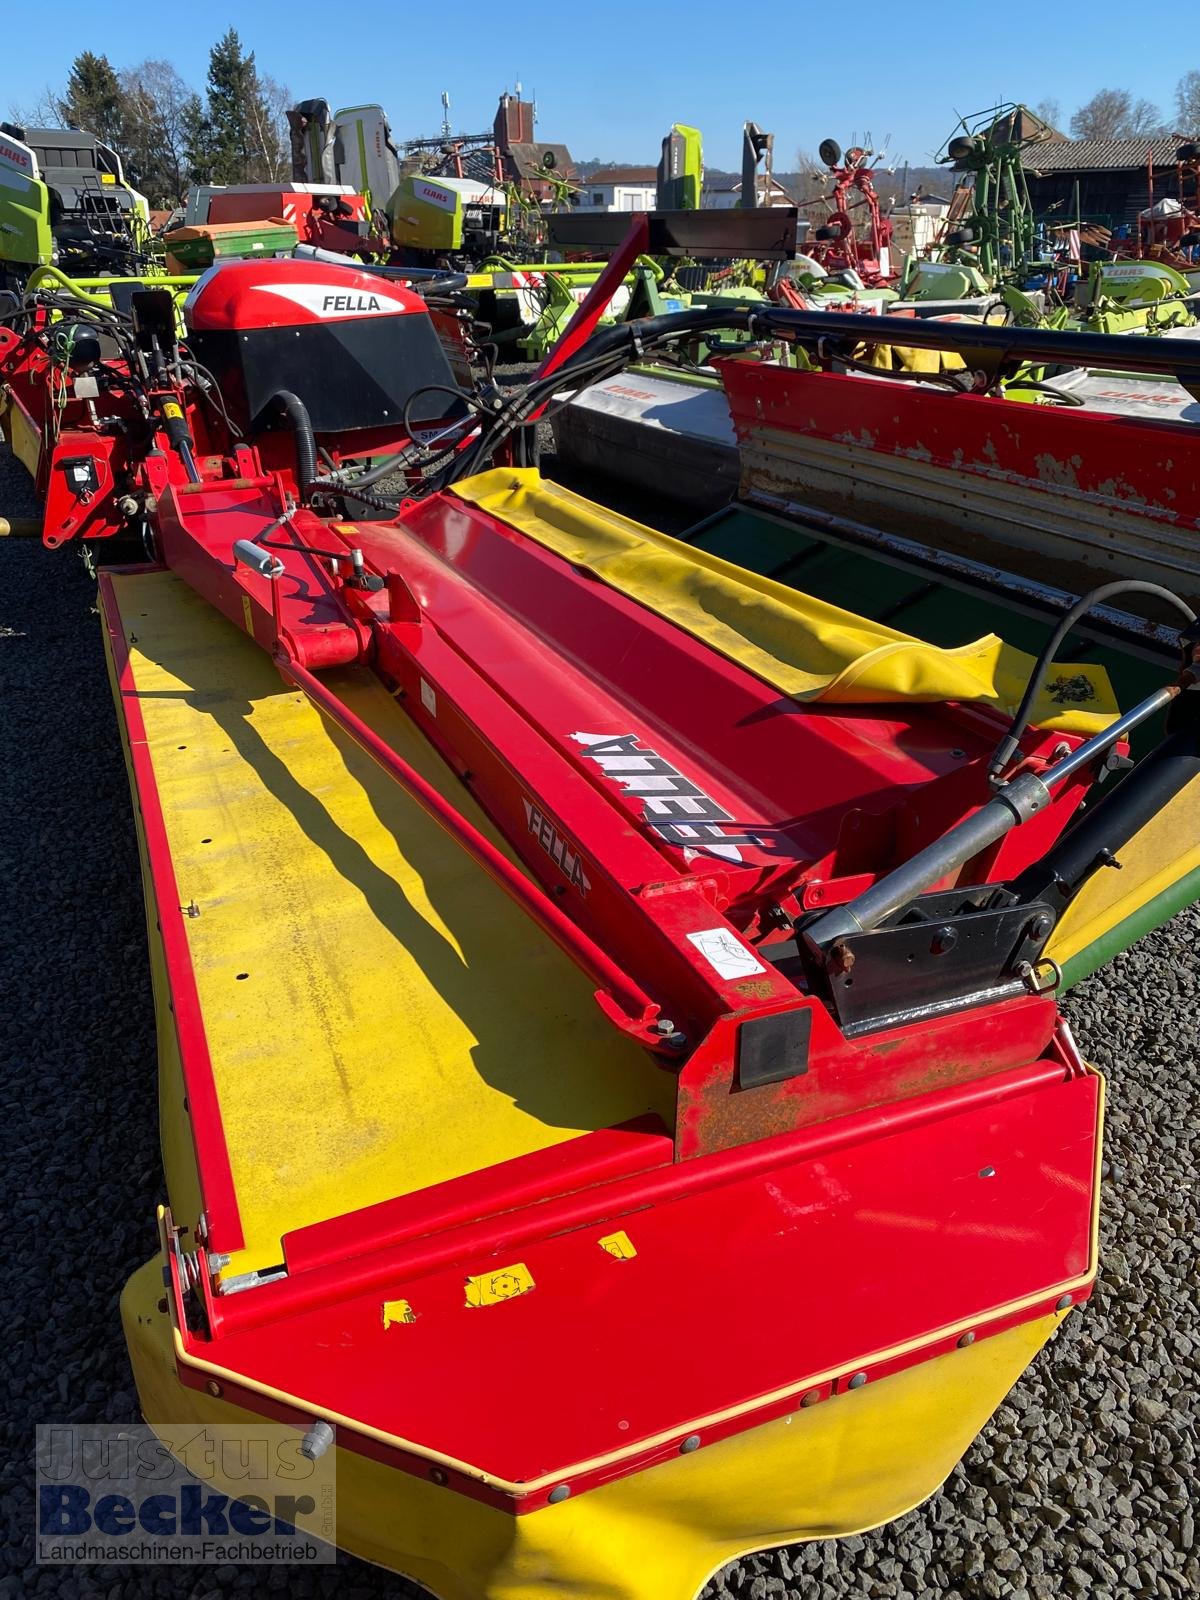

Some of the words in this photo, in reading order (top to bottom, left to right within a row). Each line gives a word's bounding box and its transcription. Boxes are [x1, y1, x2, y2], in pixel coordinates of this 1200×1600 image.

[423, 187, 449, 203] CLAAS
[323, 295, 381, 311] FELLA
[1097, 391, 1187, 404] CLAAS
[579, 733, 765, 847] FELLA
[528, 804, 587, 899] FELLA
